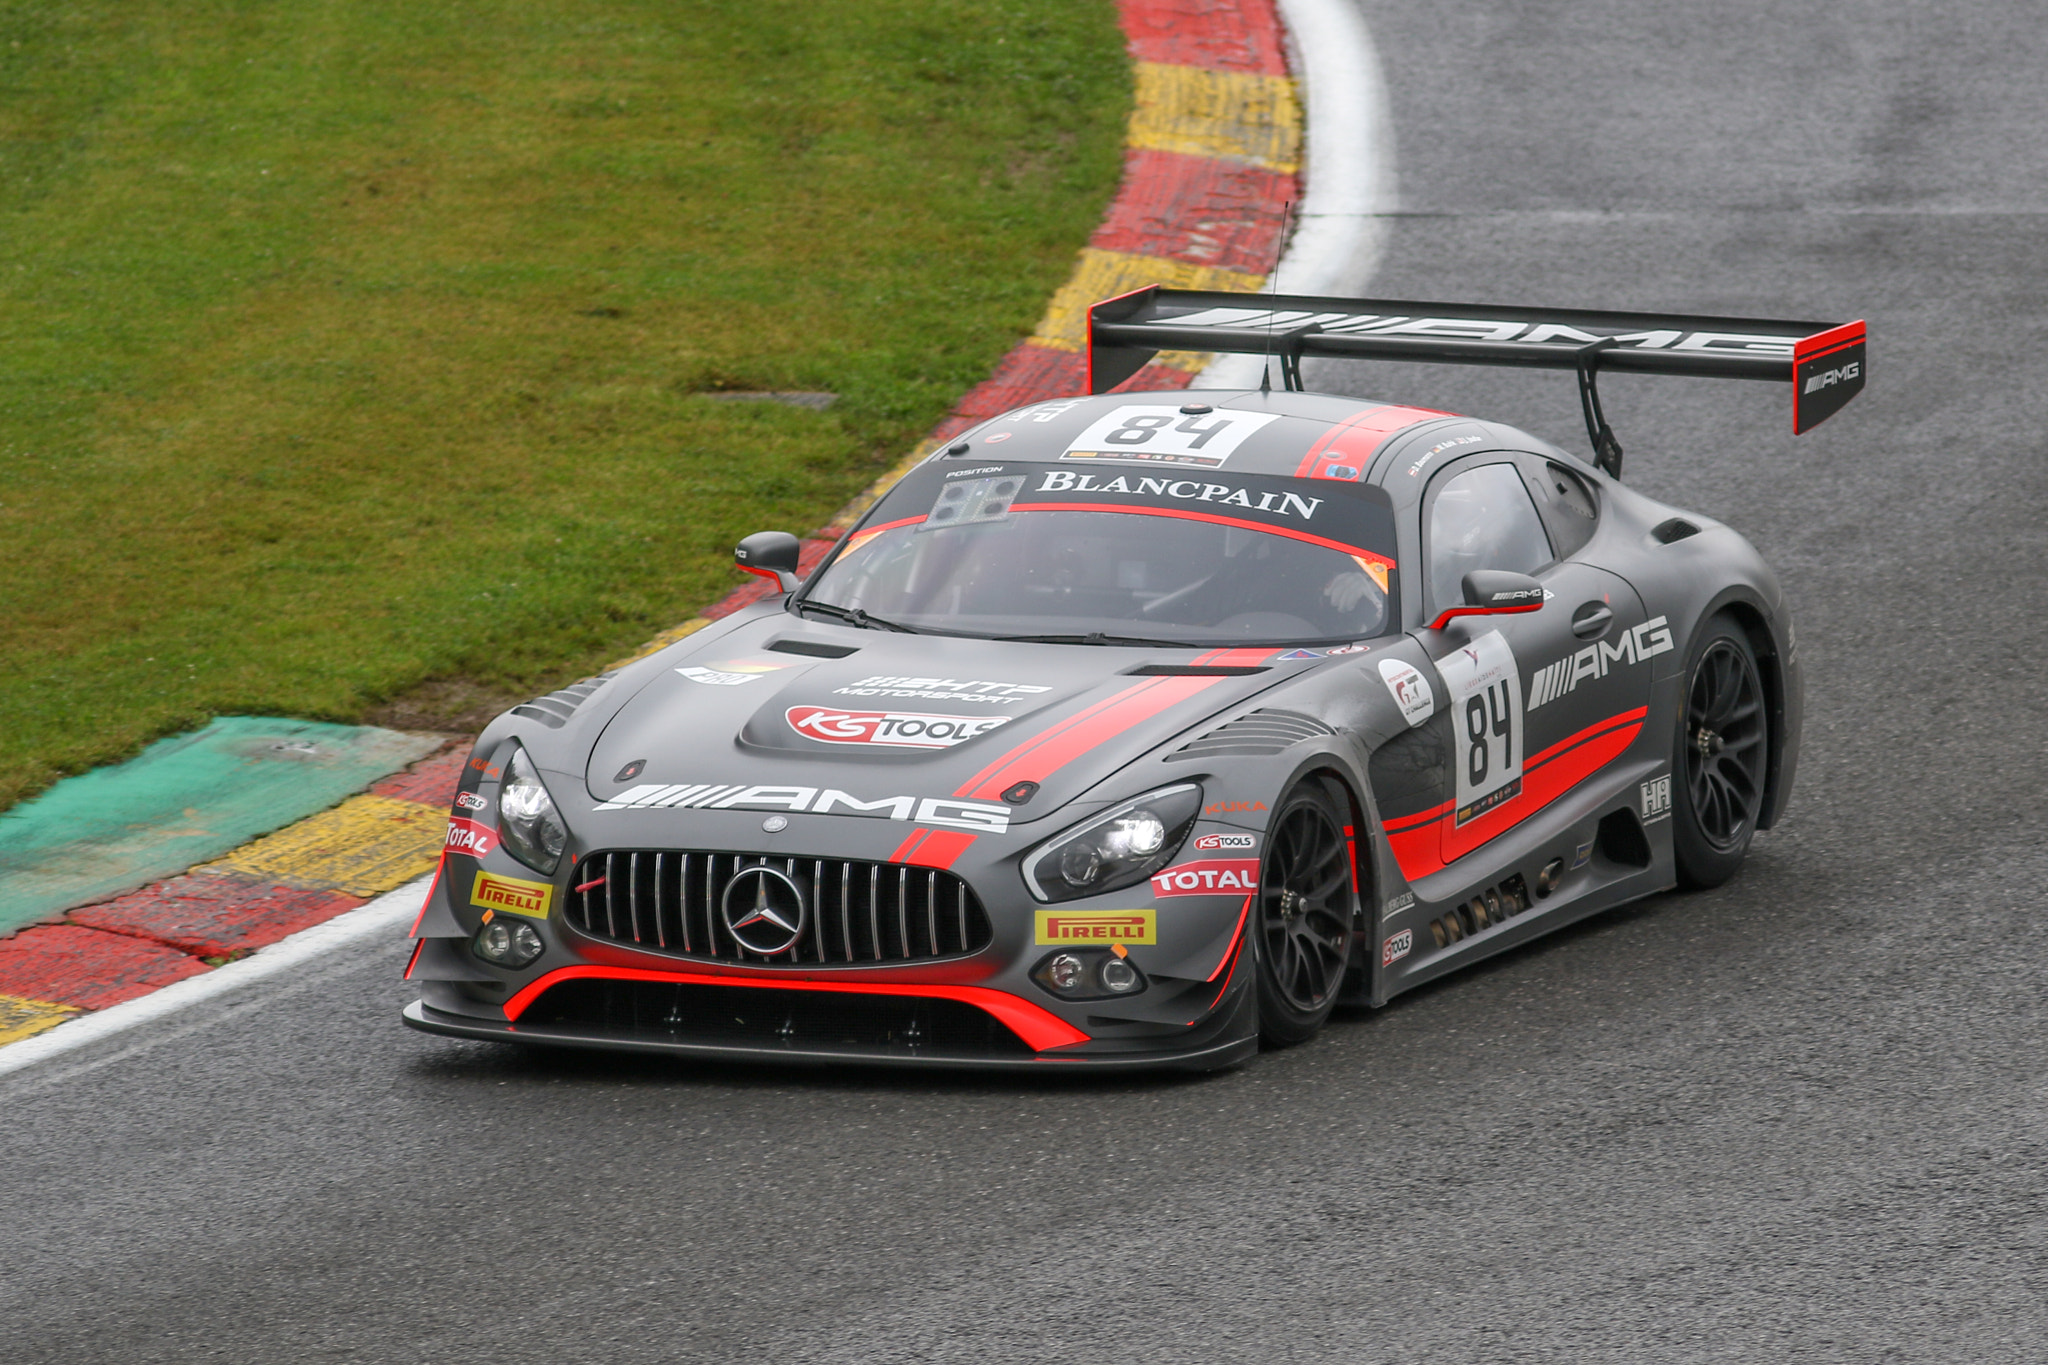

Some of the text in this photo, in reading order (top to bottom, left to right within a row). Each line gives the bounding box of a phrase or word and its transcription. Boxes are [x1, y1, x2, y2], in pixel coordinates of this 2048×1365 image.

[1103, 415, 1235, 450] 84
[946, 466, 1005, 479] POSITION
[1562, 615, 1675, 696] AMG
[832, 687, 1024, 704] MOTORSPORT
[1466, 678, 1512, 788] 84
[469, 757, 500, 778] KUKA
[706, 785, 1011, 833] AMG
[1204, 800, 1269, 815] KUKA
[446, 822, 487, 853] TOTAL
[1151, 869, 1258, 890] TOTAL
[477, 878, 545, 911] PIRELLI
[1047, 917, 1146, 938] PIRELLI
